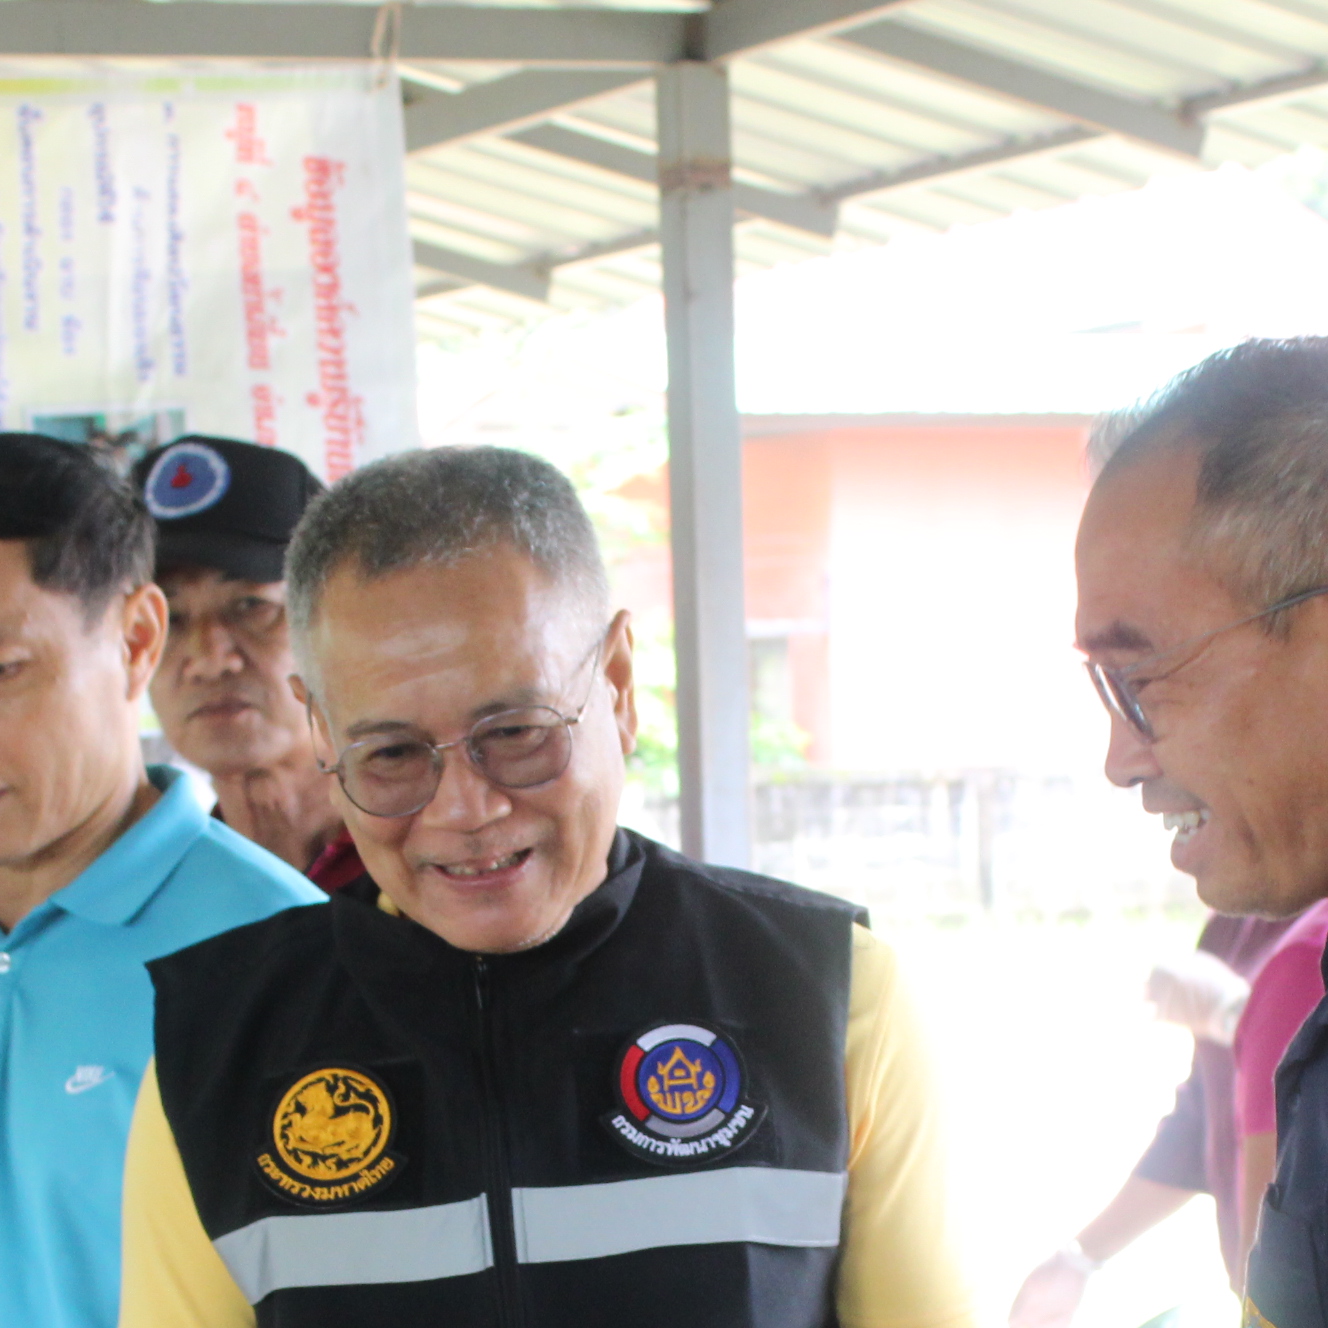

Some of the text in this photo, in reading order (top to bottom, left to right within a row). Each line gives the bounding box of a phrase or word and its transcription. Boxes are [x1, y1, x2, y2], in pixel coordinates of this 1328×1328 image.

[611, 1104, 755, 1157] กรมการพัฒนาชุมชน
[256, 1153, 396, 1200] กระทรวงมหาดไทย
